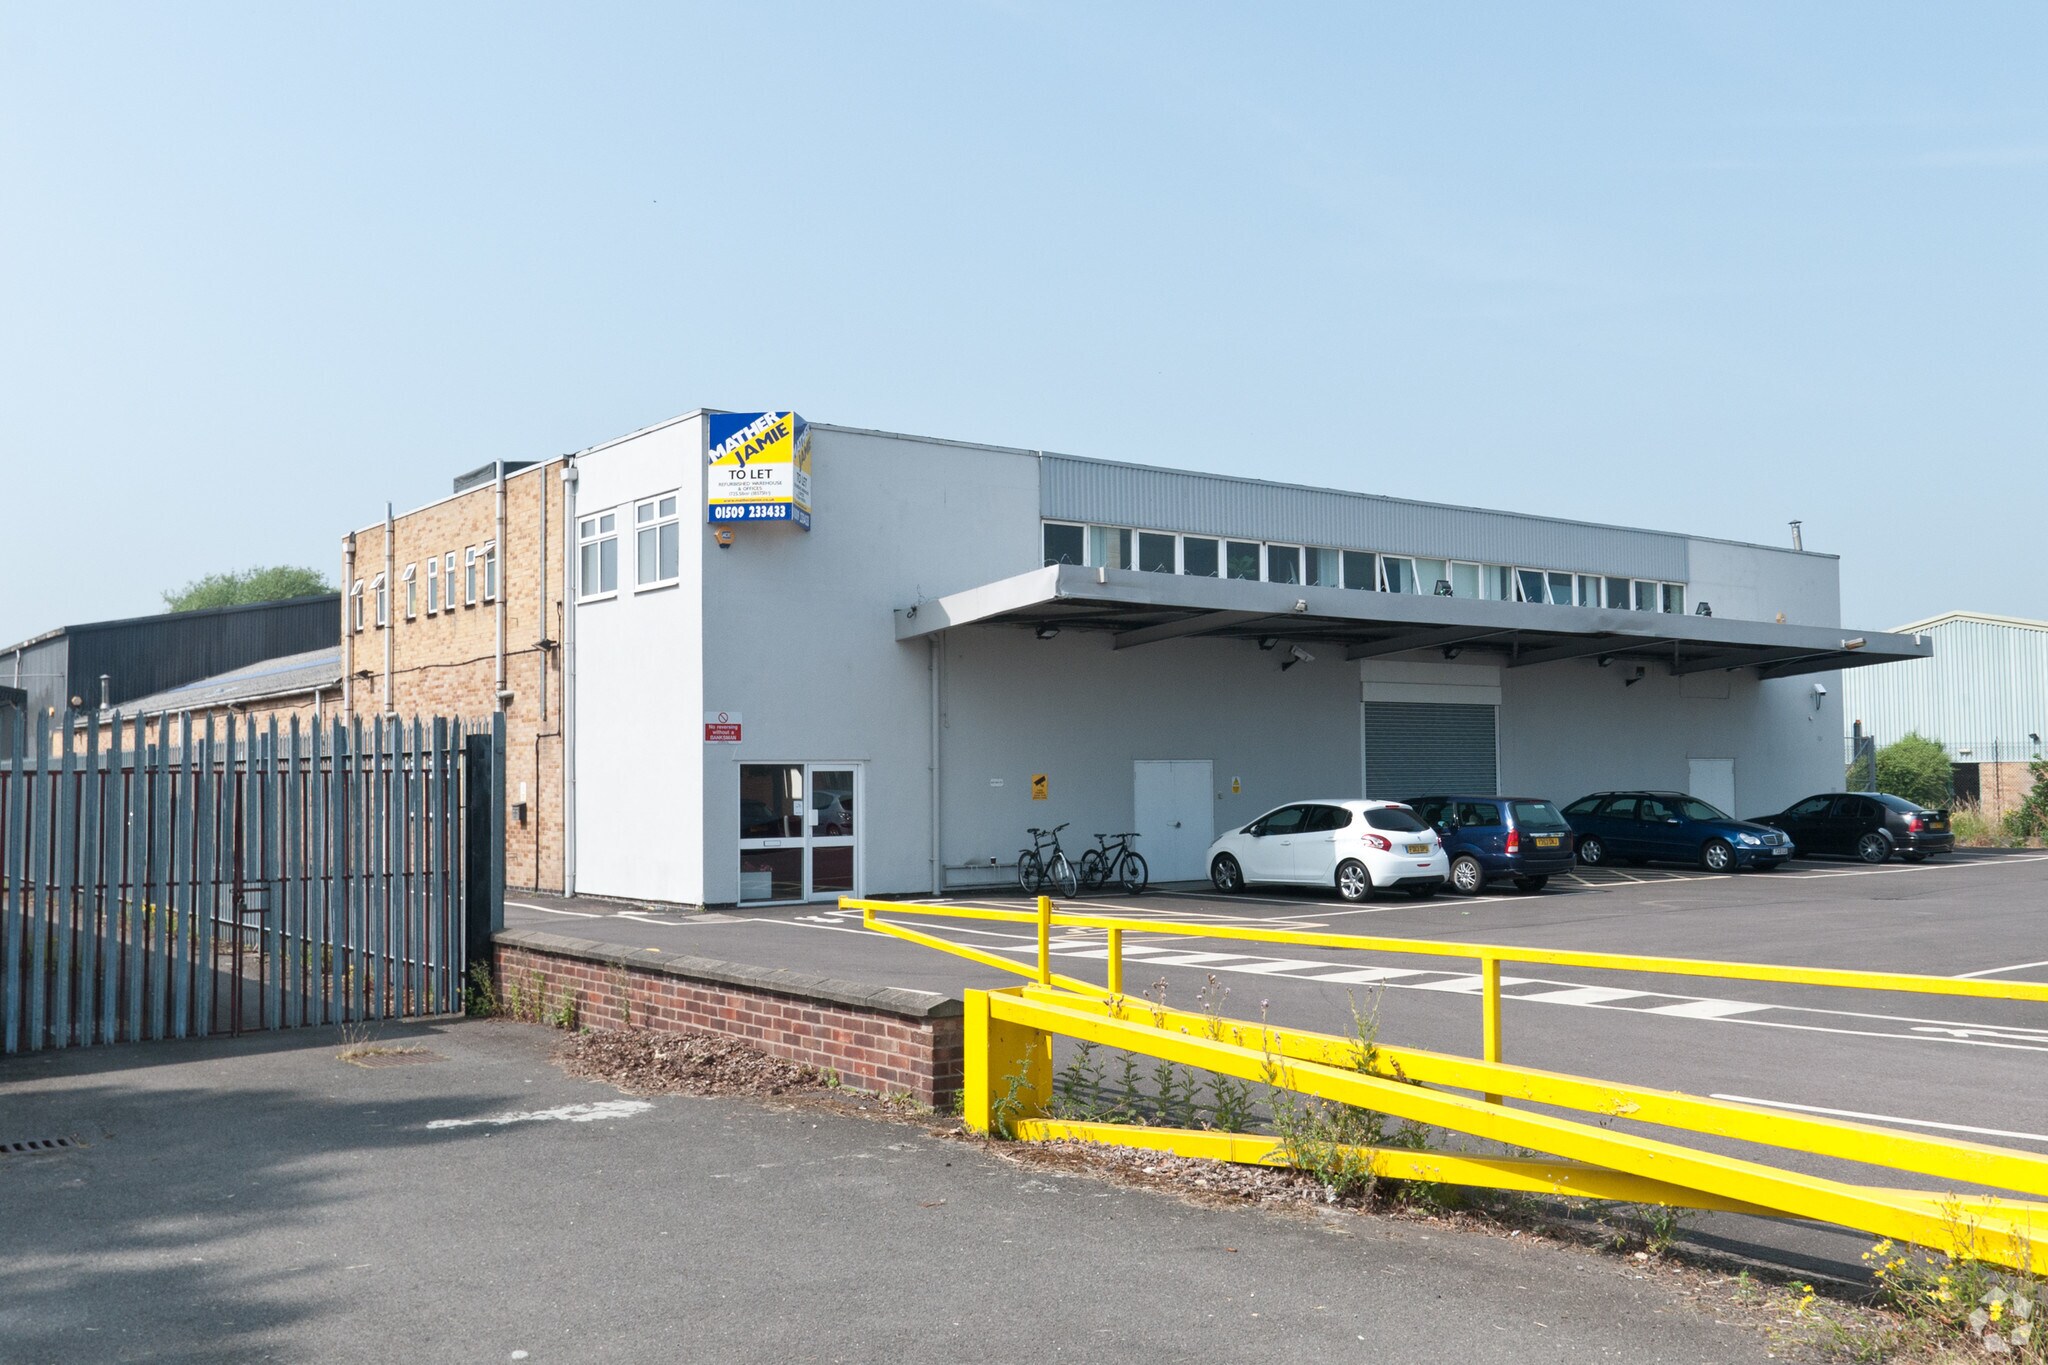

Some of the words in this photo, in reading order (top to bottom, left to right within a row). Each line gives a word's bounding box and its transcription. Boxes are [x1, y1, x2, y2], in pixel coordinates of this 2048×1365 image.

[709, 411, 781, 463] MATHER
[735, 422, 790, 468] JAMIE
[729, 470, 746, 480] TO
[751, 469, 773, 479] LET
[715, 506, 745, 519] 01509
[749, 505, 786, 518] 233433
